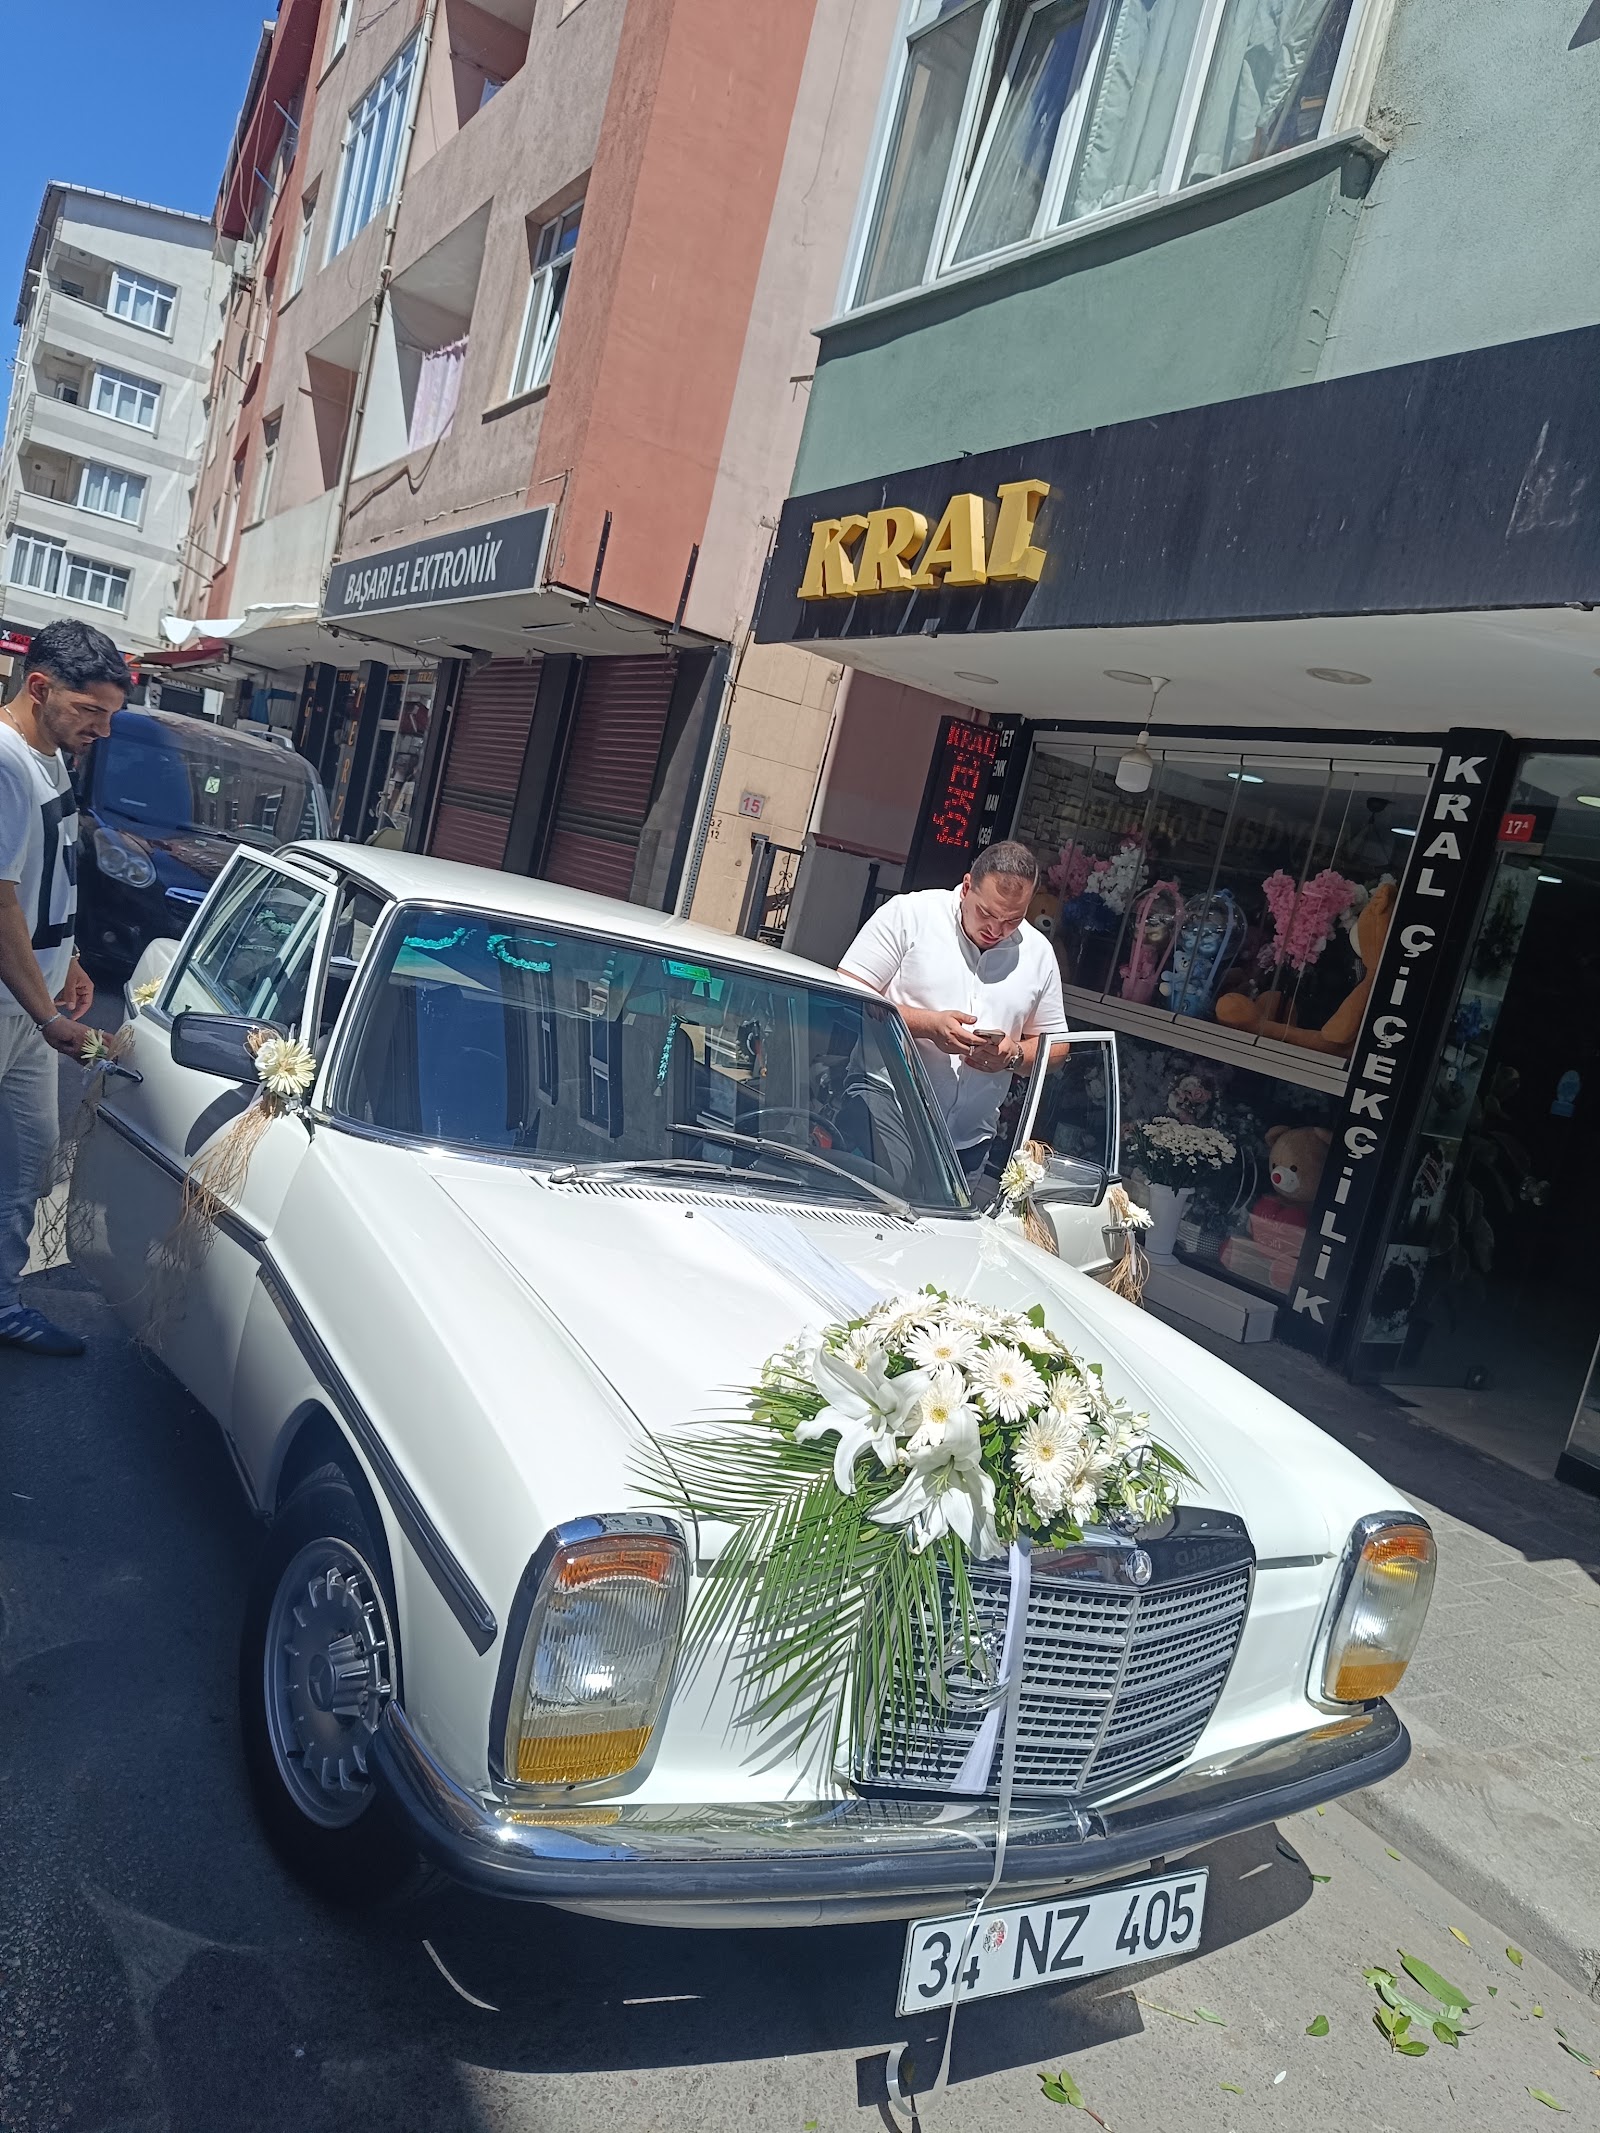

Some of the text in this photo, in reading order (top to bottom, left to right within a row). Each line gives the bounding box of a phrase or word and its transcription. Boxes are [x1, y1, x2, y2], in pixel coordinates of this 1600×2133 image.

[344, 564, 394, 611] BAŞARI
[796, 478, 1051, 600] KRAL
[743, 797, 761, 813] 15
[1291, 755, 1489, 1326] KRAL ÇİÇEKÇİLİK
[917, 1923, 982, 2000] 34
[1013, 1905, 1092, 1981] NZ
[1115, 1882, 1197, 1956] 405
